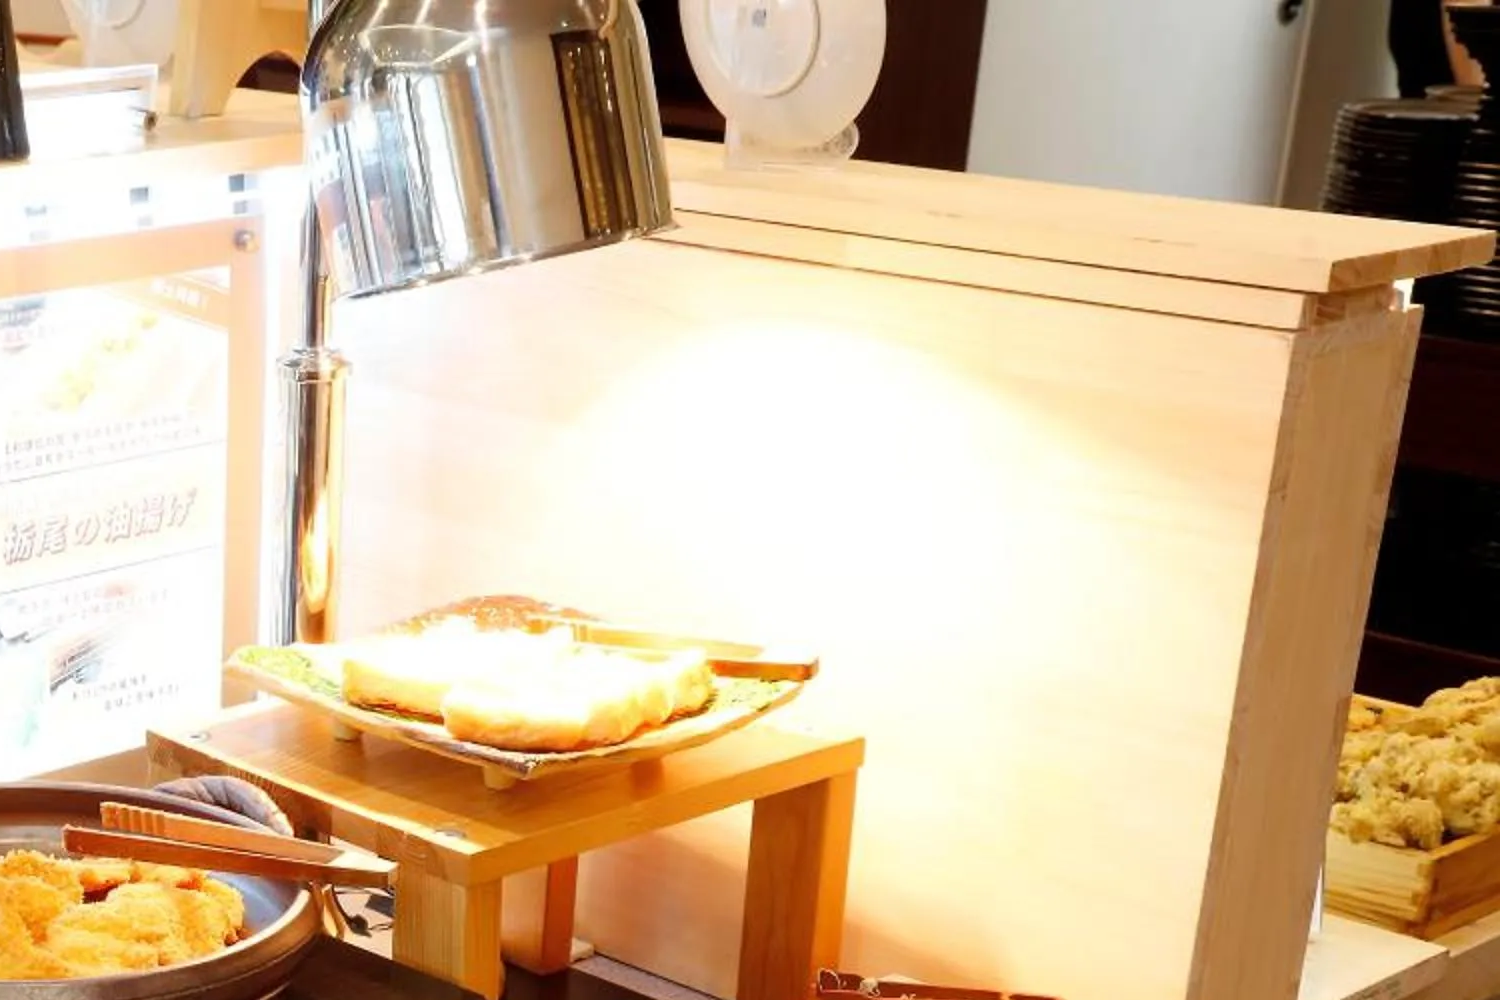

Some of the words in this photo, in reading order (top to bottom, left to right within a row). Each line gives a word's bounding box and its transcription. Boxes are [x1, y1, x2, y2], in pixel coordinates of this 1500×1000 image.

[0, 488, 199, 566] 栃尾の油揚げ
